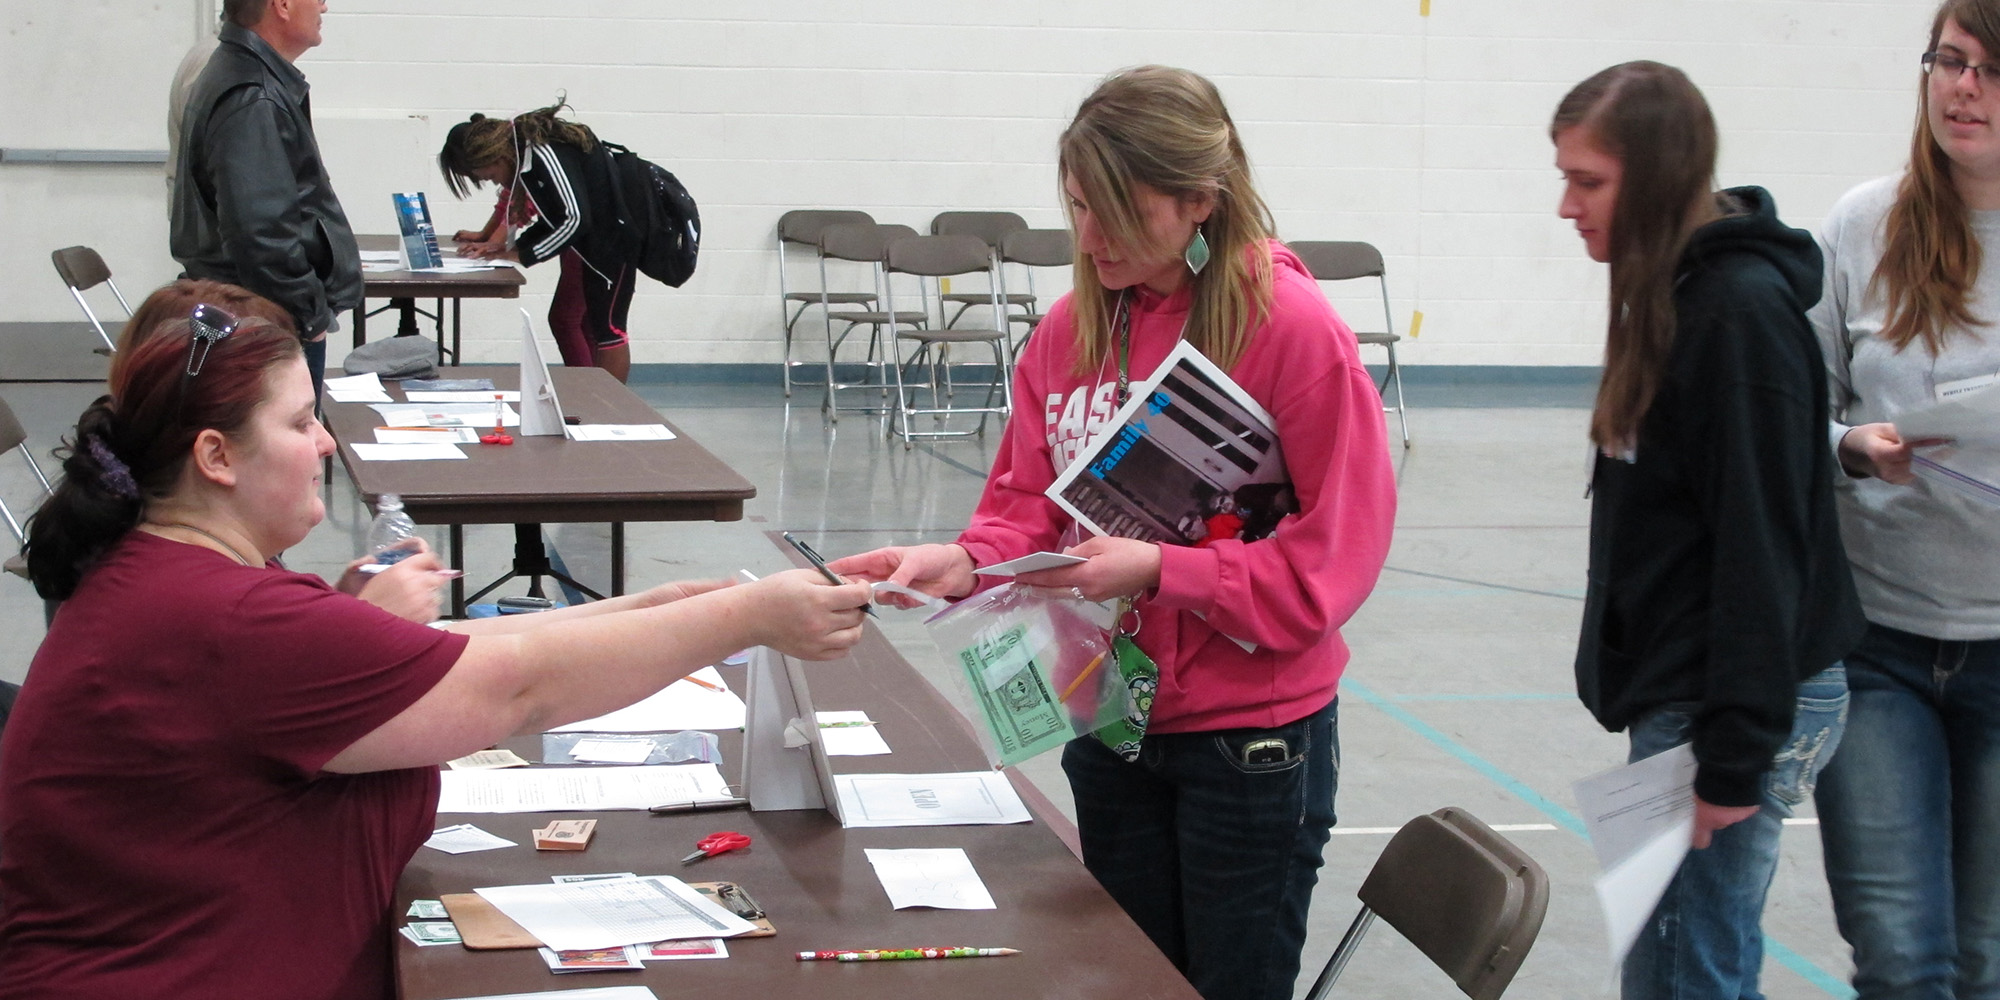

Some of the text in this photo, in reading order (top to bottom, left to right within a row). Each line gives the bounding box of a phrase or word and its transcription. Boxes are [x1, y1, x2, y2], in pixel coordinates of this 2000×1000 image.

[1089, 391, 1171, 480] Family 40
[908, 788, 942, 809] OPEN
